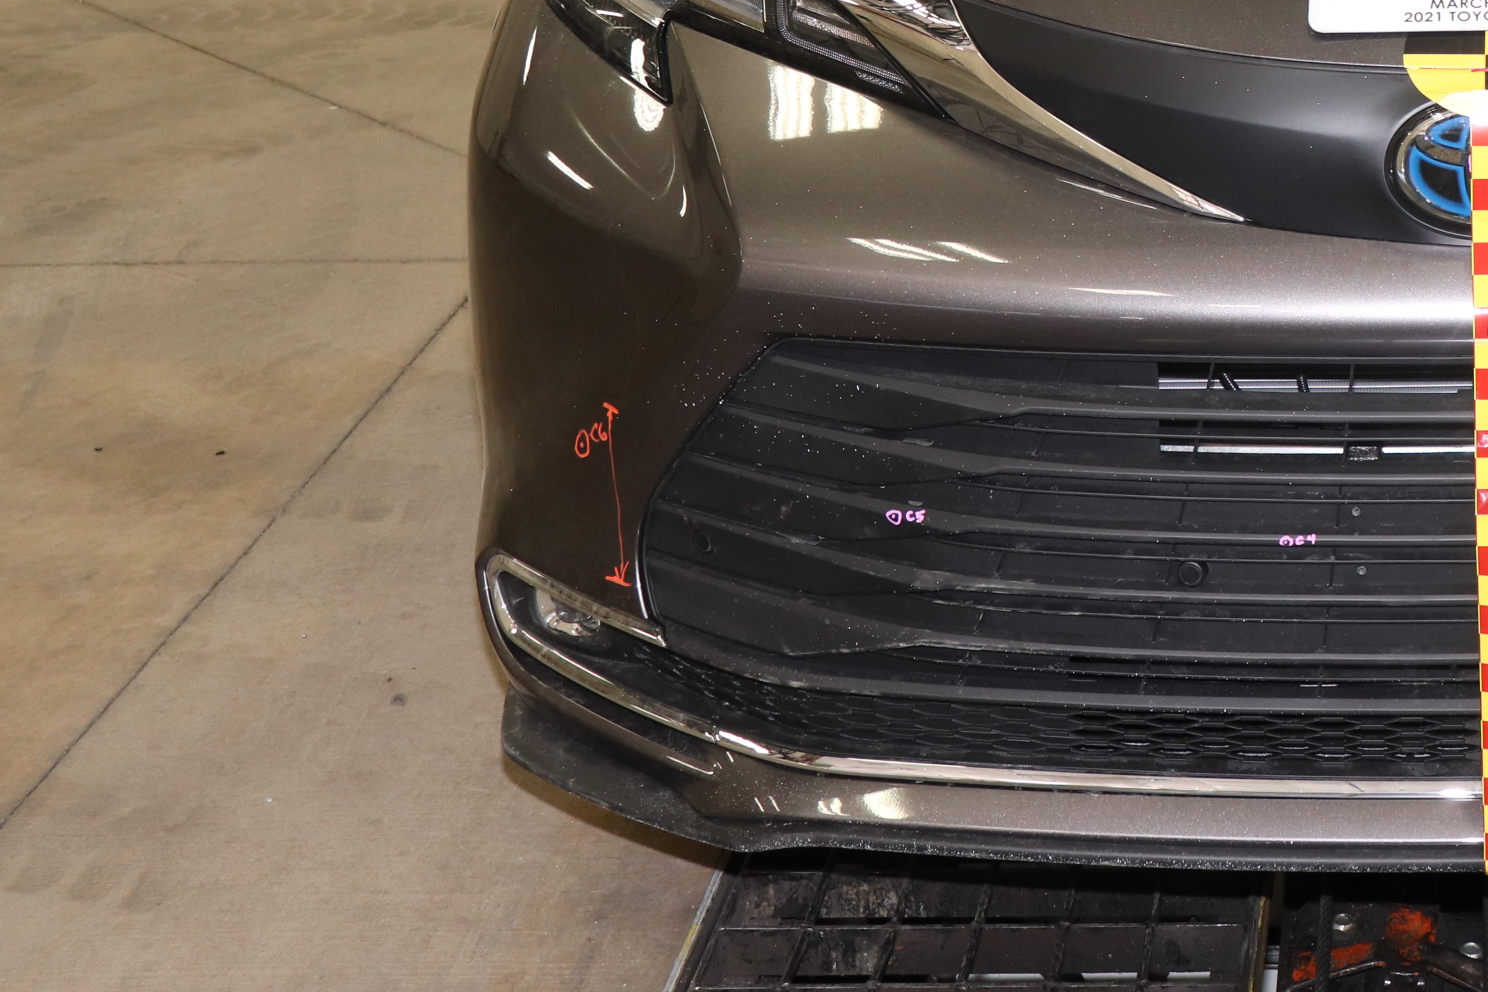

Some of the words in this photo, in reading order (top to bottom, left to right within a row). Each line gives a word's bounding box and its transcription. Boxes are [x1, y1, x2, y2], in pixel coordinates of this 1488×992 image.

[1404, 11, 1442, 22] 2021
[590, 422, 608, 442] C6
[906, 509, 926, 523] C5
[1295, 533, 1316, 545] C4
